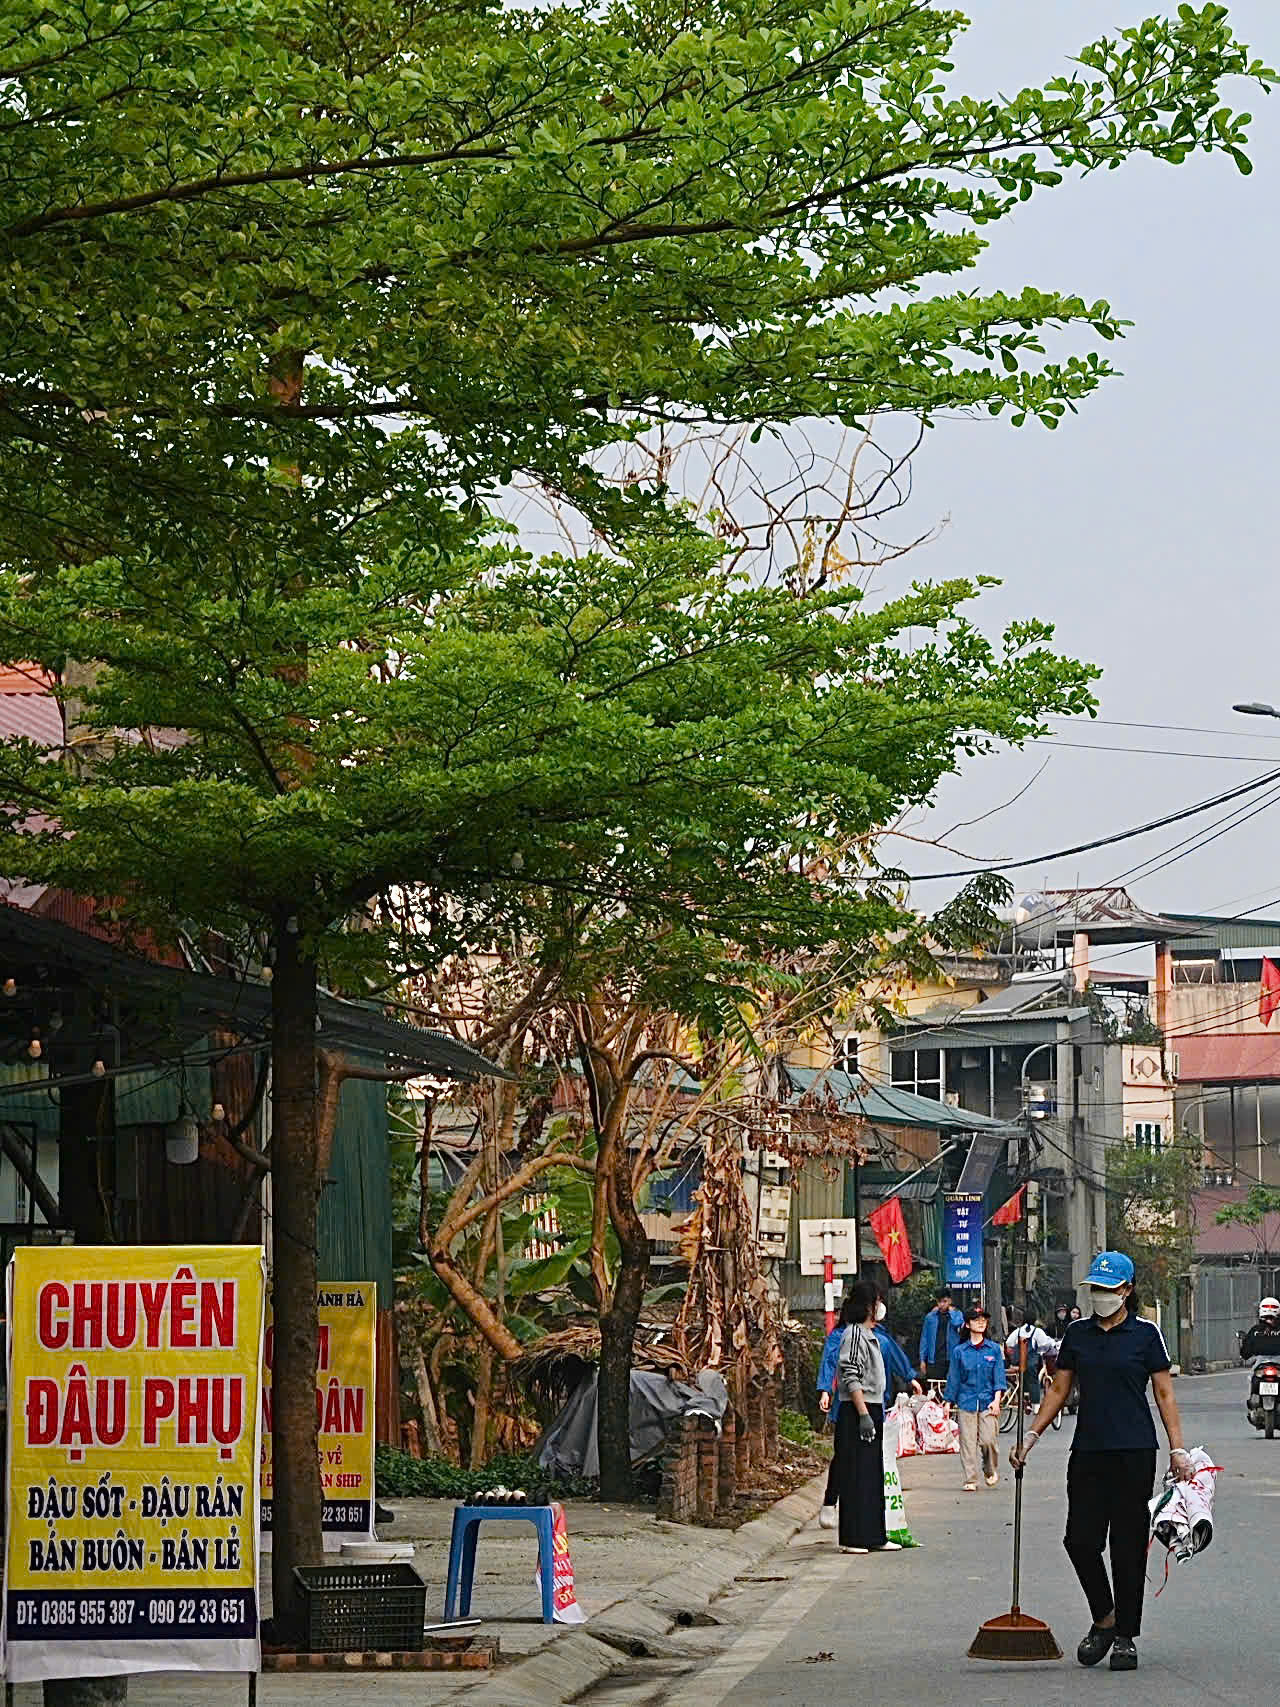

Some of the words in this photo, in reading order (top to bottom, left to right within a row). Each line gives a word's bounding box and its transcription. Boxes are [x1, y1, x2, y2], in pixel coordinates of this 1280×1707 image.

[39, 1267, 235, 1349] CHUYÊN
[346, 1289, 365, 1307] HÀ
[25, 1364, 128, 1461] ĐẬU
[143, 1377, 243, 1460] PHỤ
[335, 1473, 362, 1488] SHIP
[27, 1476, 77, 1527] ĐẬU
[82, 1471, 125, 1518] SỐT
[141, 1475, 190, 1527] ĐẬU
[195, 1475, 244, 1518] RÁN
[322, 1506, 334, 1522] 22
[335, 1506, 346, 1522] 33
[348, 1506, 363, 1522] 651
[29, 1529, 77, 1571] BÁN
[82, 1529, 145, 1571] BUÔN
[161, 1529, 209, 1571] BÁN
[214, 1525, 241, 1570] LẺ
[16, 1600, 38, 1625] ĐT:
[41, 1600, 76, 1625] 0385
[79, 1600, 106, 1625] 955
[109, 1600, 135, 1625] 387
[149, 1600, 175, 1625] 090
[178, 1600, 196, 1625] 22
[199, 1600, 218, 1625] 33
[221, 1600, 246, 1625] 651
